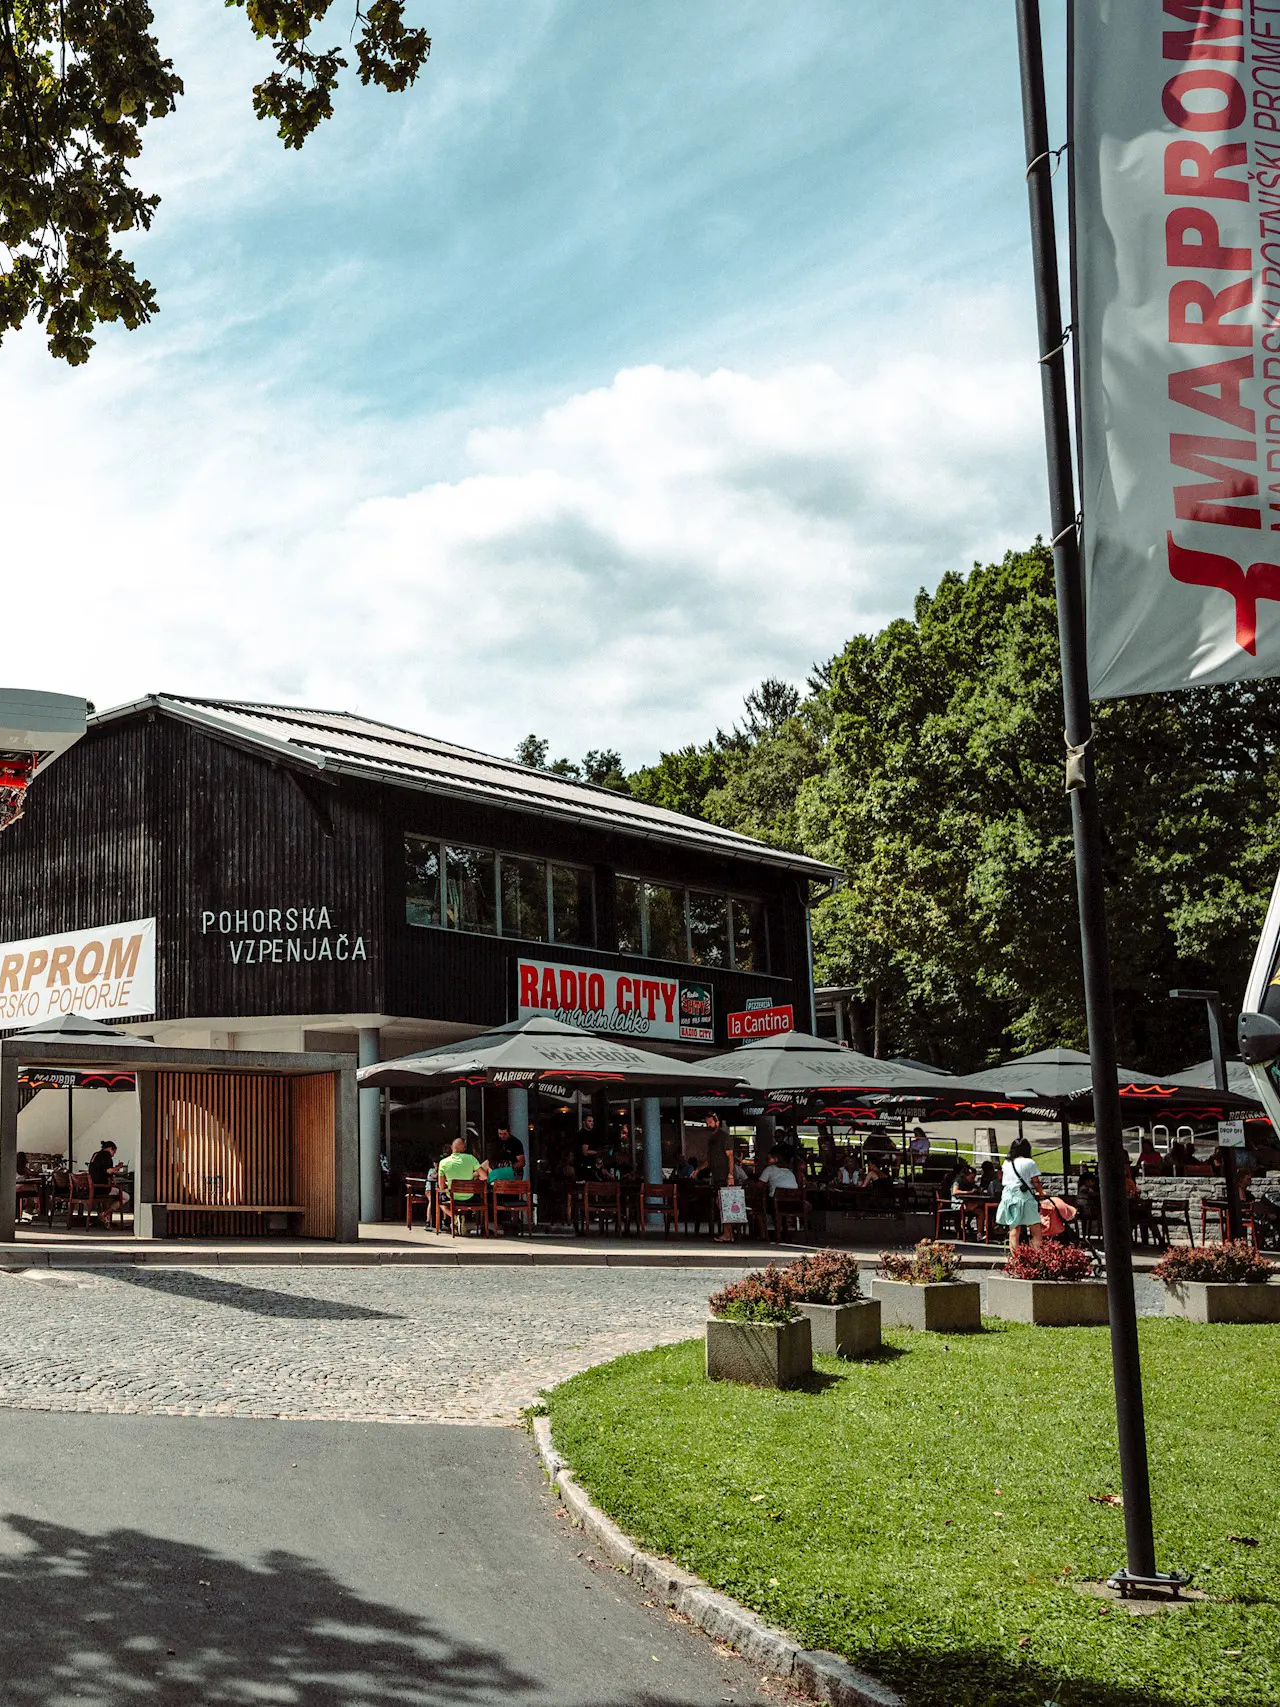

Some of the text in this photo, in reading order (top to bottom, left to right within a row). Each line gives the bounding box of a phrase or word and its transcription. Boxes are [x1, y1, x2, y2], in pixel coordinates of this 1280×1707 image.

[1160, 0, 1261, 530] MARPROM
[202, 906, 332, 935] POHORSKA
[230, 933, 367, 964] VZPENJAČA
[47, 980, 133, 1014] POHORJE
[519, 964, 677, 1023] RADIO CITY
[572, 1009, 608, 1032] nam
[609, 1007, 650, 1036] lahko
[731, 1012, 790, 1035] la Cantina
[539, 1051, 646, 1063] MARIBOR
[33, 1073, 76, 1086] MARIBOR
[493, 1071, 536, 1082] MARIBOR
